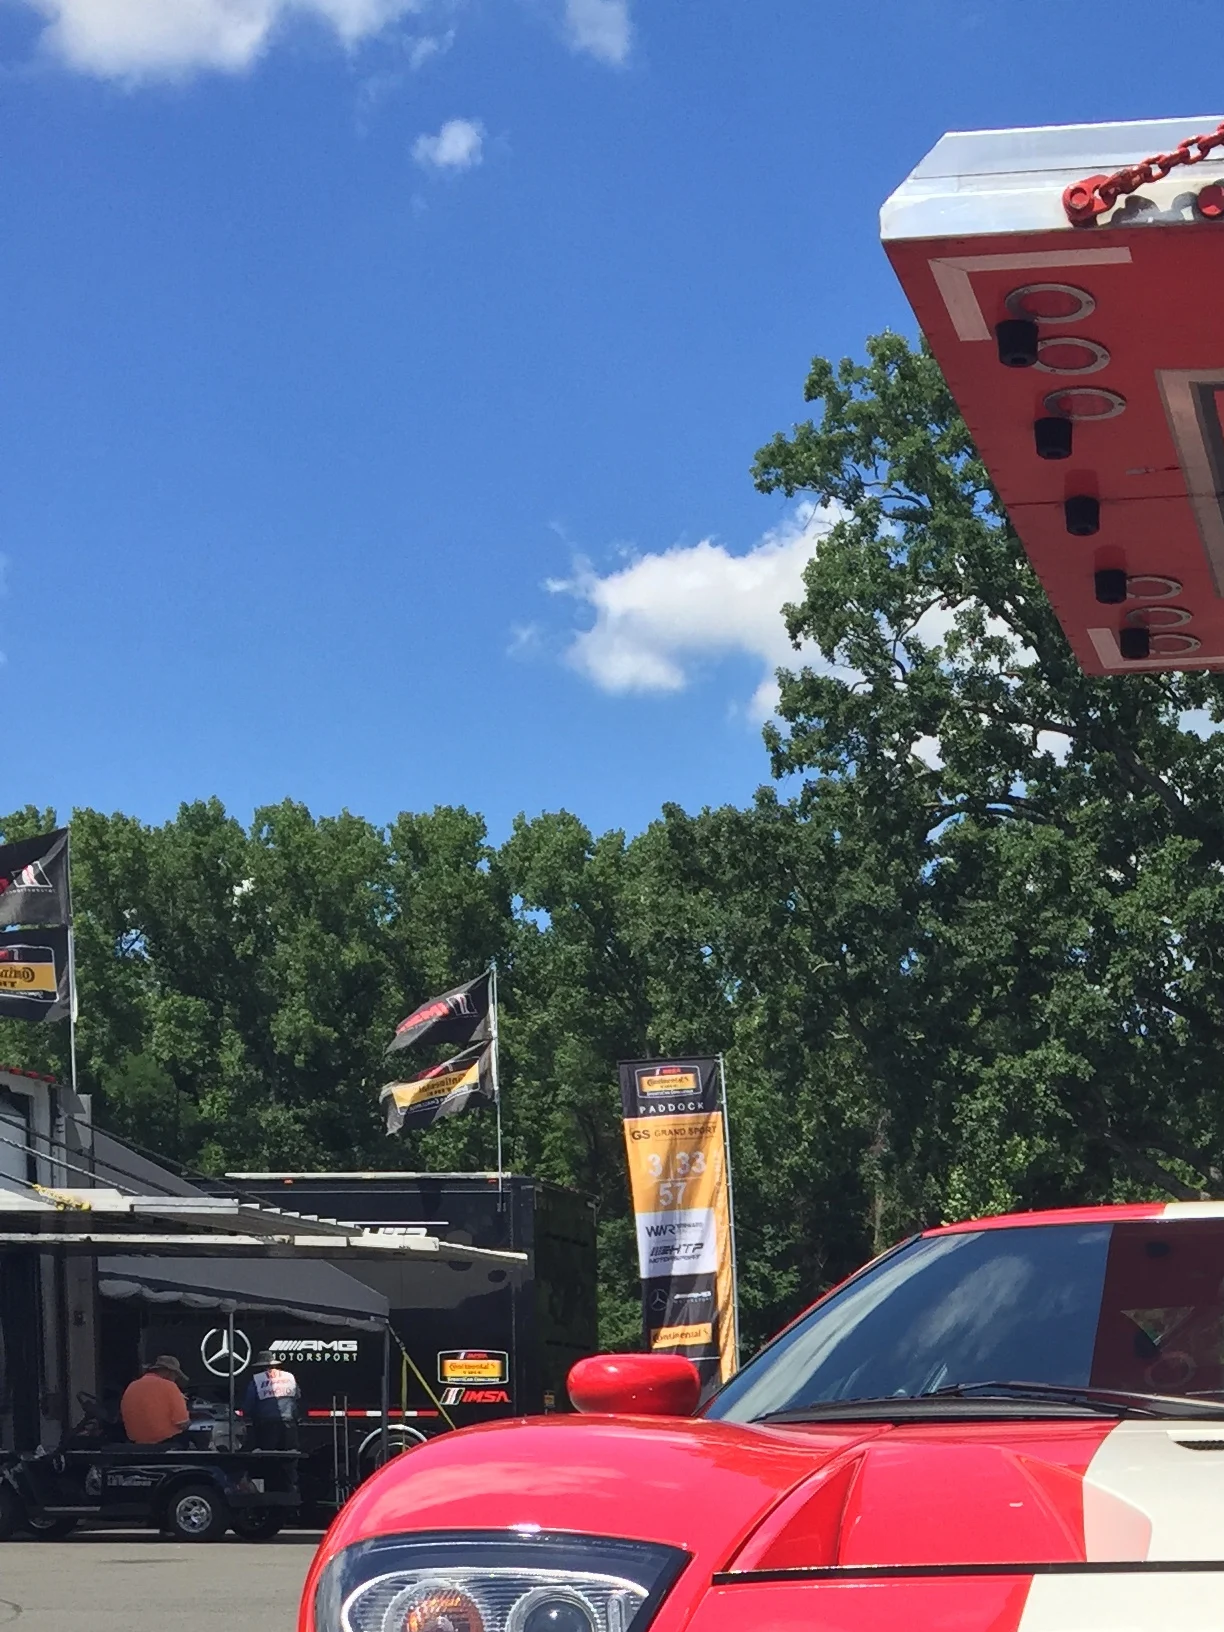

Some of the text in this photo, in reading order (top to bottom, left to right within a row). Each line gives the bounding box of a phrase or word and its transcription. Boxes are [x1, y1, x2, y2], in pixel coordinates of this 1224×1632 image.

[639, 1101, 704, 1114] PADDOCK
[631, 1125, 717, 1141] GS GRAND SPORT
[659, 1181, 687, 1206] 57
[296, 1340, 358, 1351] AMG
[461, 1390, 512, 1403] IMSA
